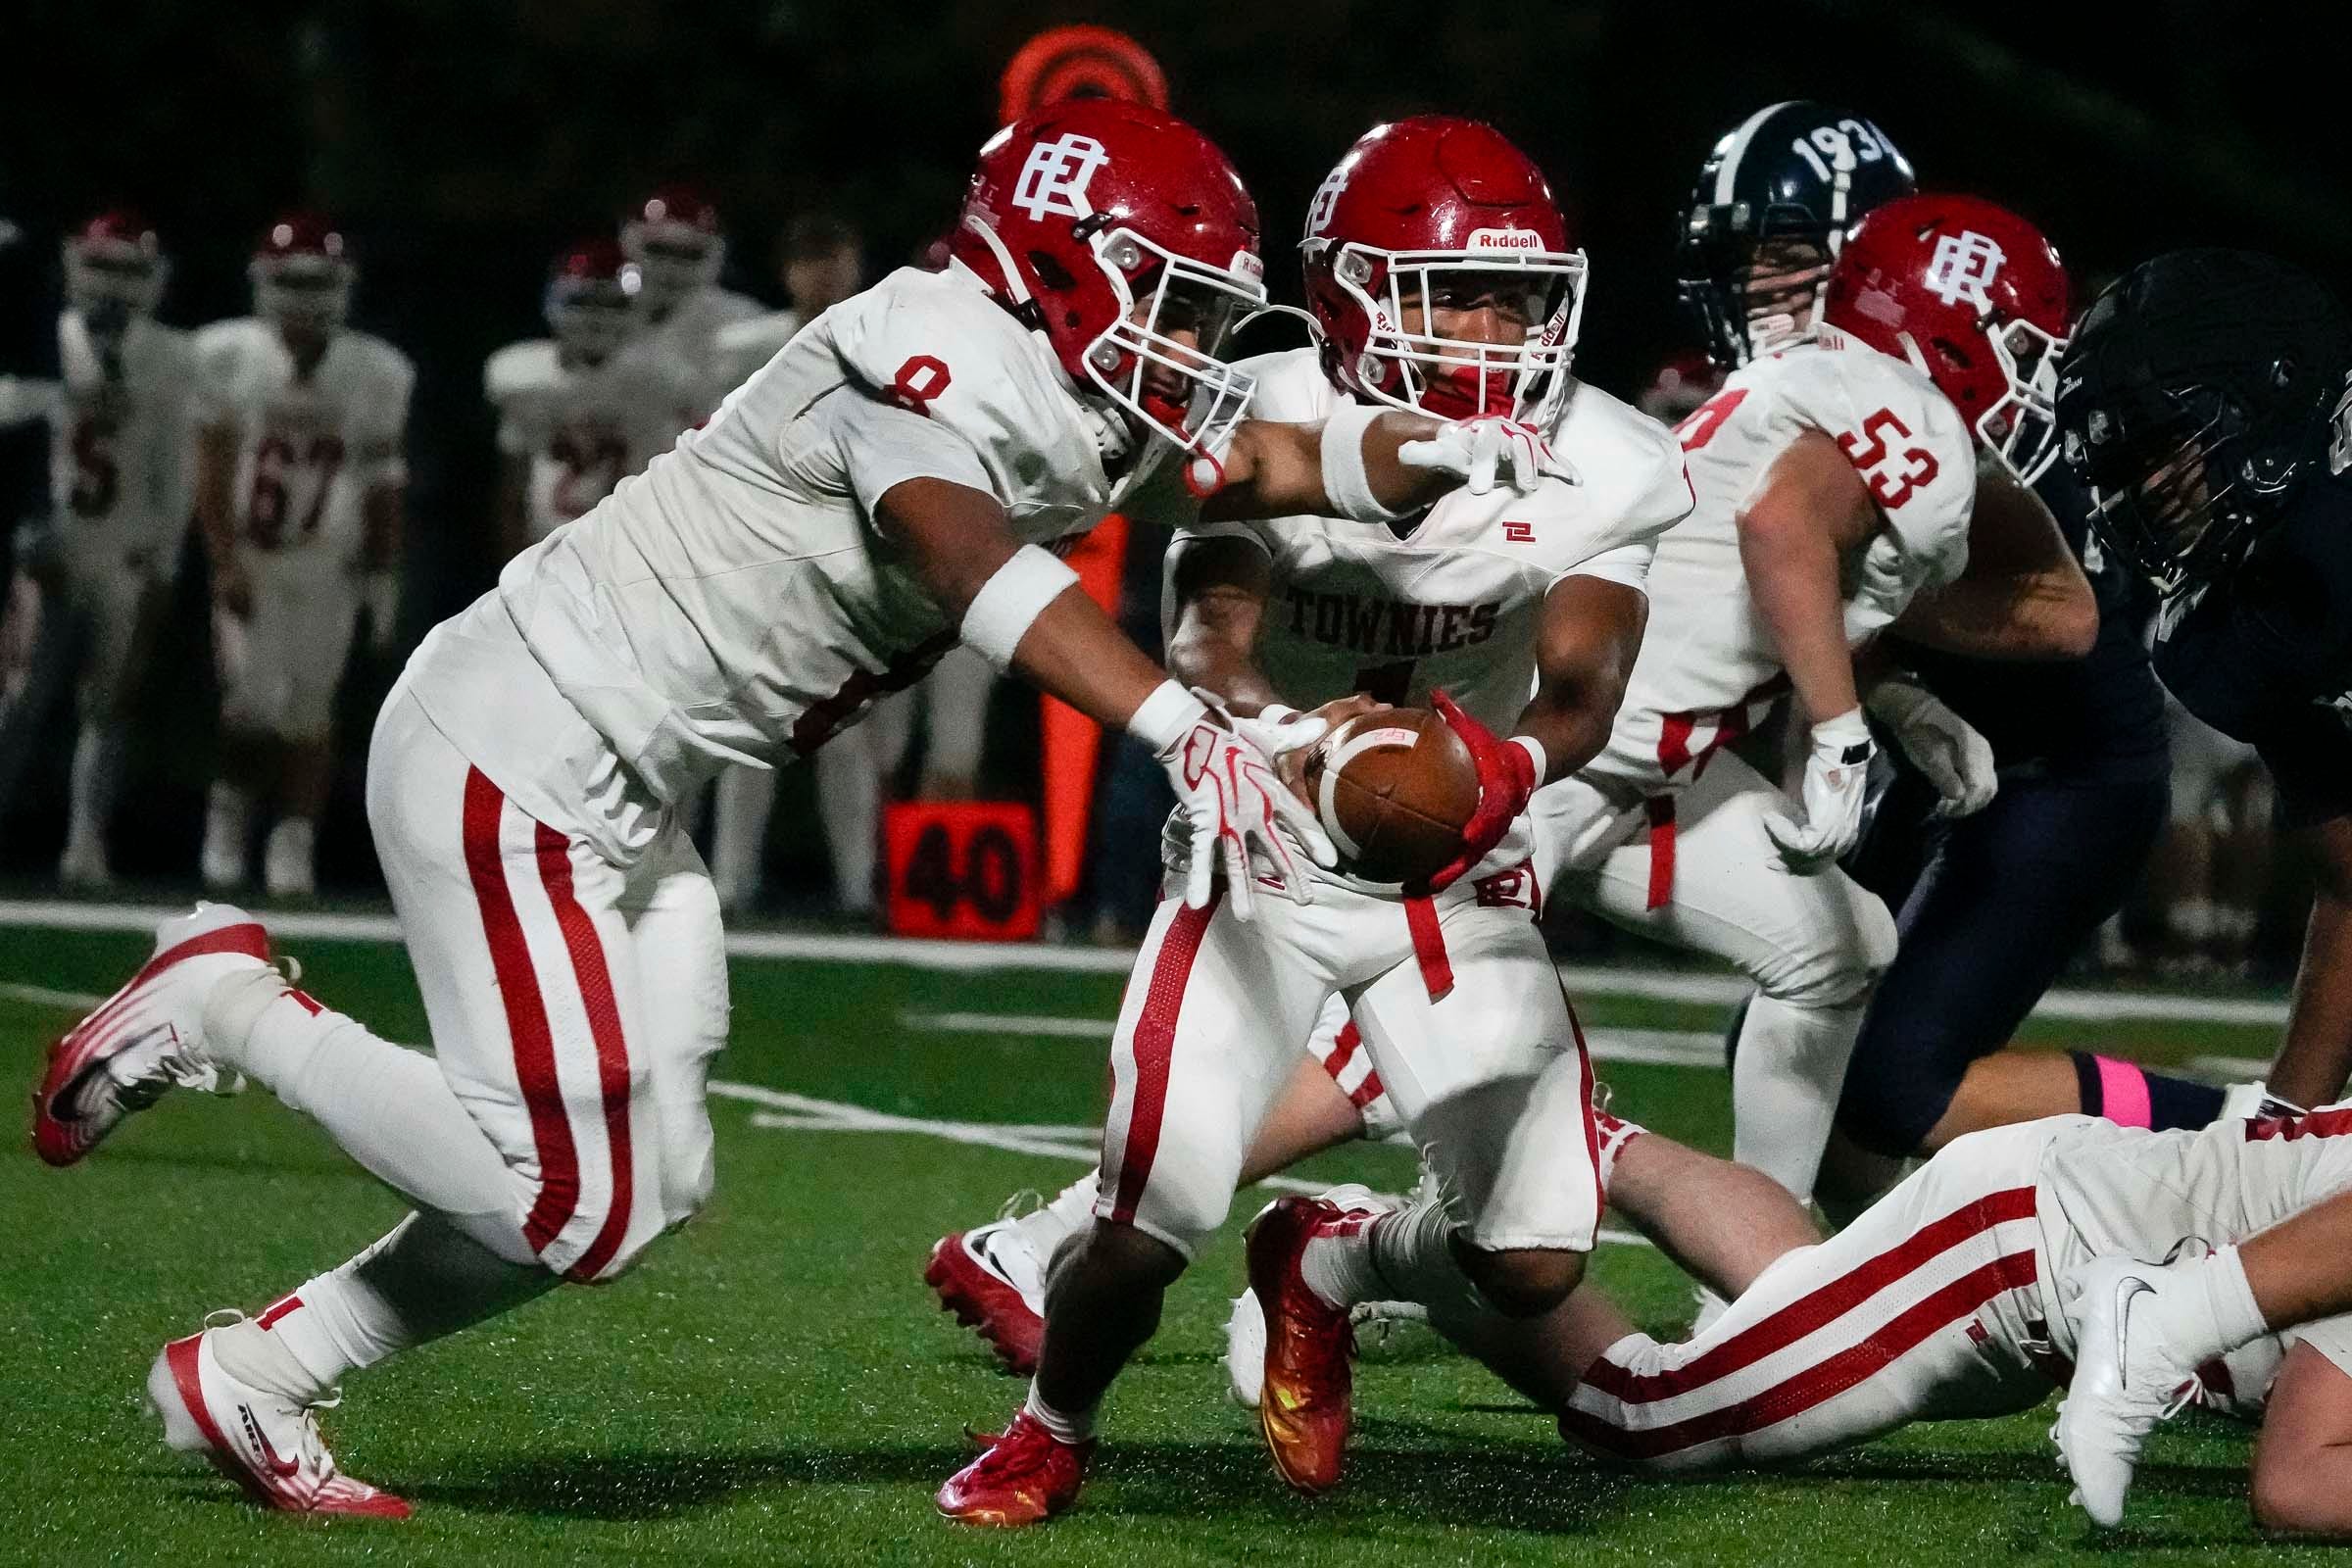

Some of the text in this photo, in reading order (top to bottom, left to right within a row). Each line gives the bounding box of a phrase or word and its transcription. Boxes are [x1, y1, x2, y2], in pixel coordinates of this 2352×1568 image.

[1480, 233, 1547, 249] Riddell
[1530, 313, 1566, 362] Rddell
[249, 437, 345, 549] 67
[1838, 407, 1939, 510] 53
[1286, 588, 1500, 657] TOWNIES
[906, 822, 1022, 923] 40
